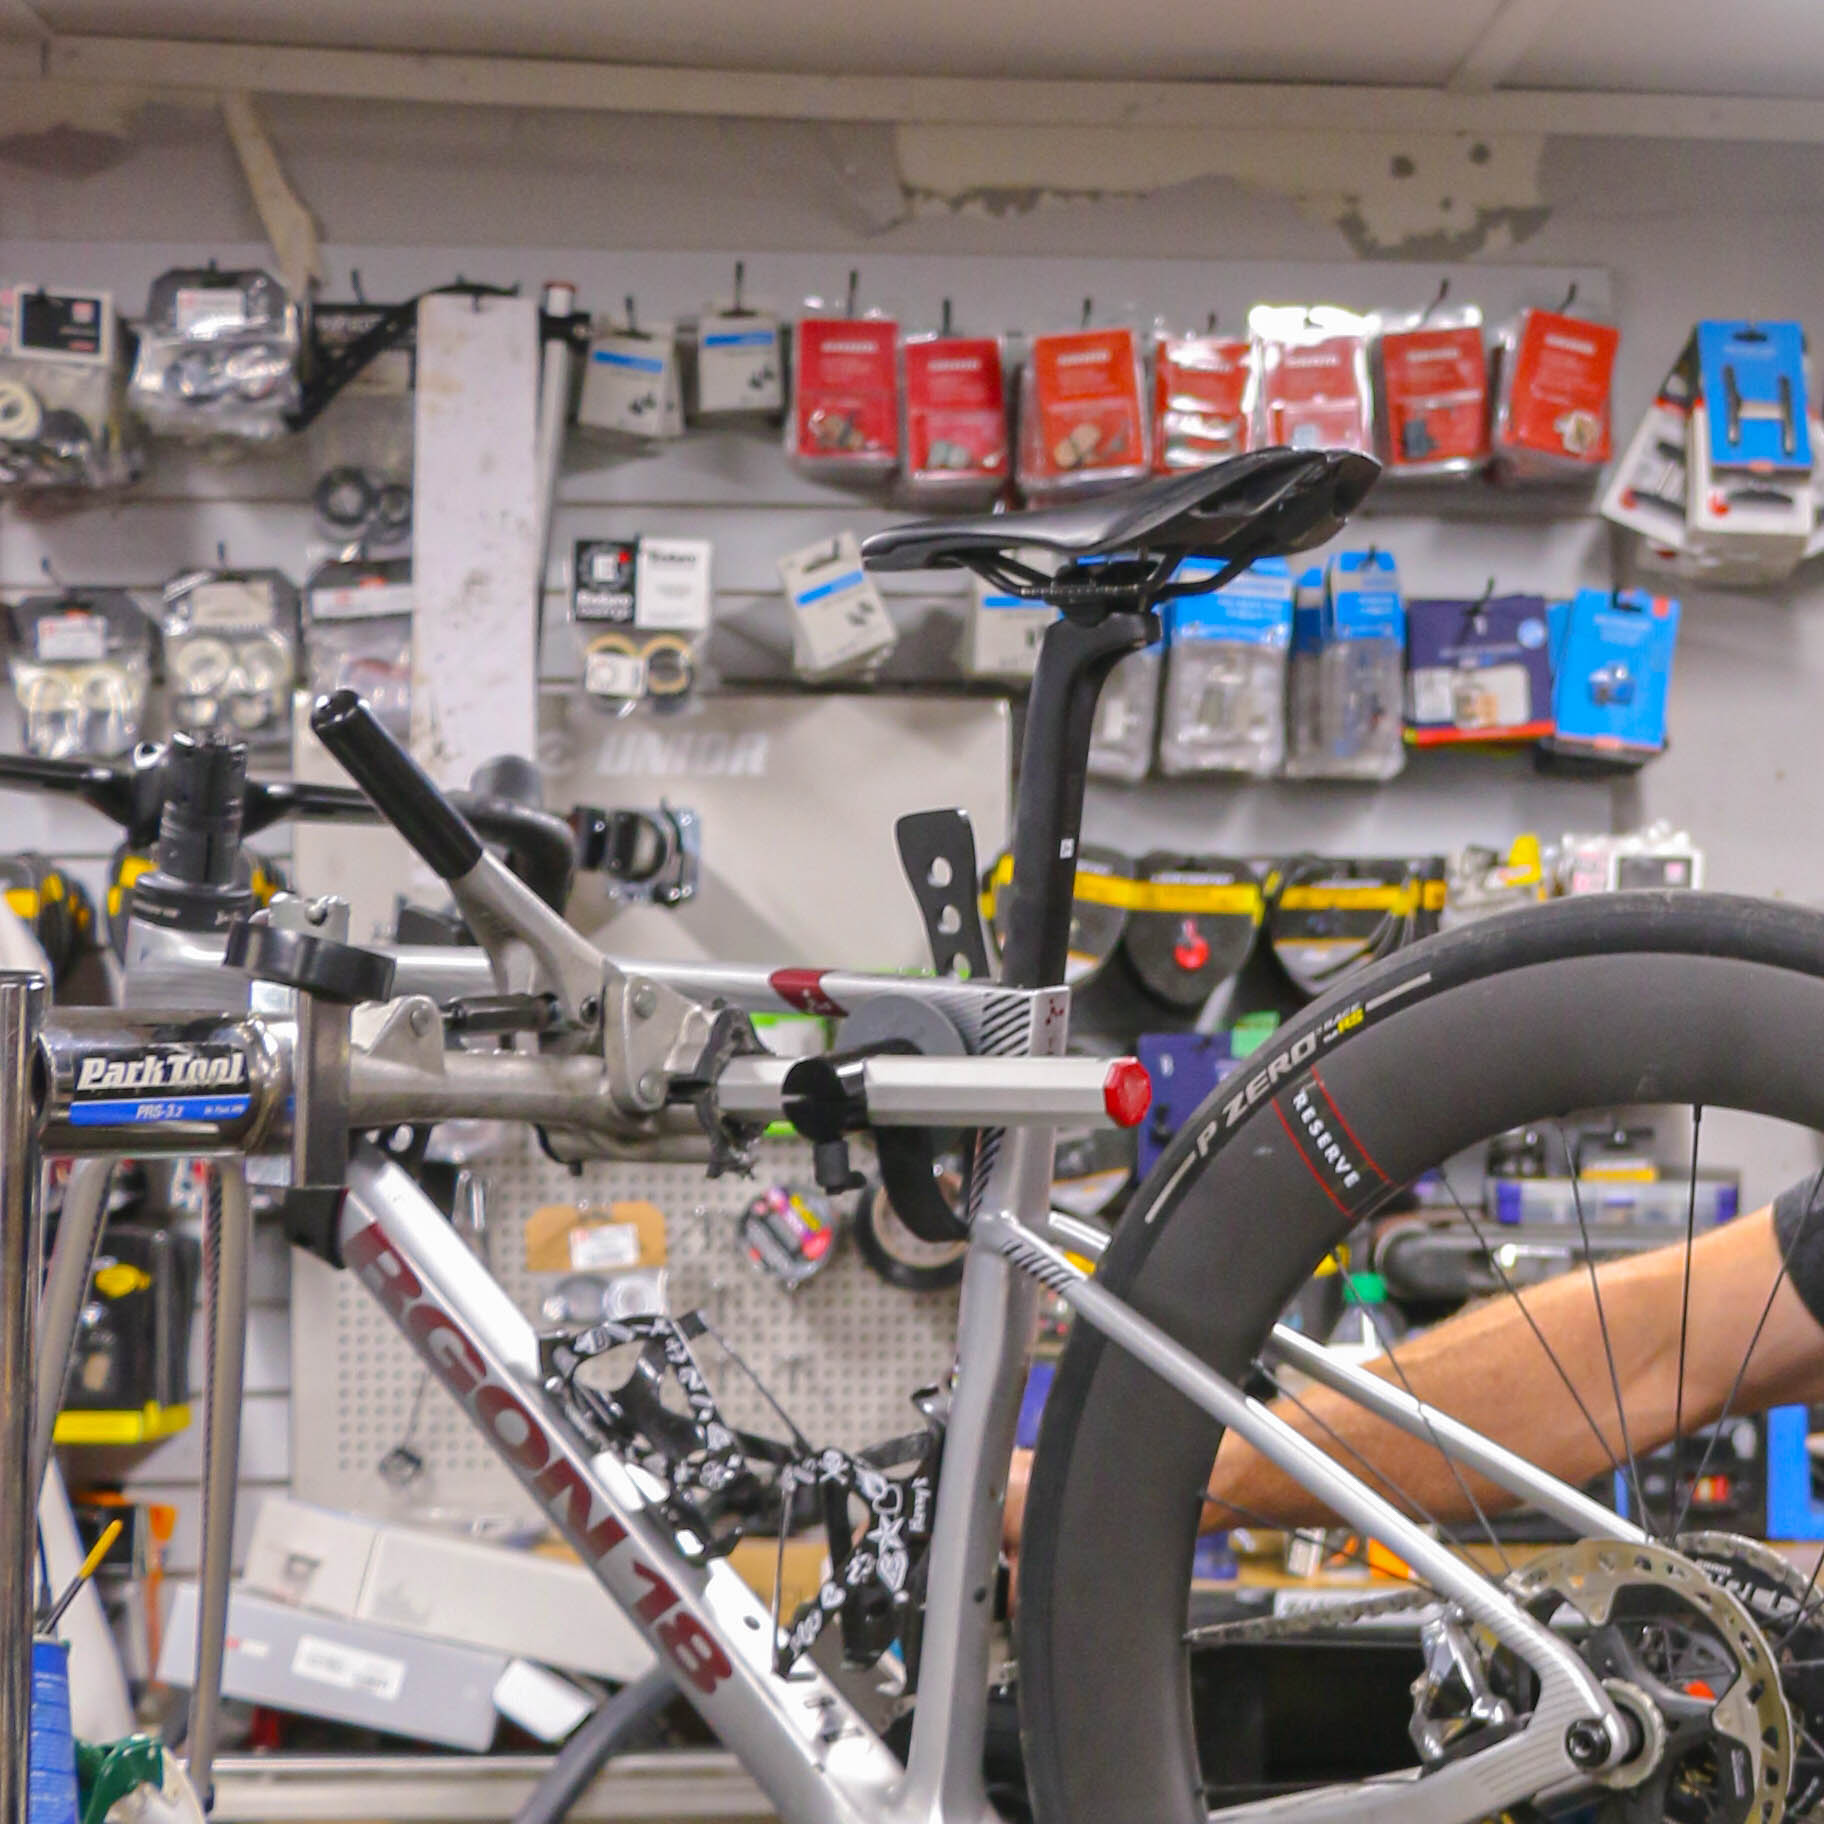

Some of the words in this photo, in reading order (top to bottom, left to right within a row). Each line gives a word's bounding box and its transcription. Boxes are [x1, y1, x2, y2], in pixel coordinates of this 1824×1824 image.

[1196, 1121, 1218, 1159] P
[1222, 1032, 1317, 1127] ZERO
[1292, 1087, 1361, 1189] RESERVE
[632, 1559, 733, 1694] 18
